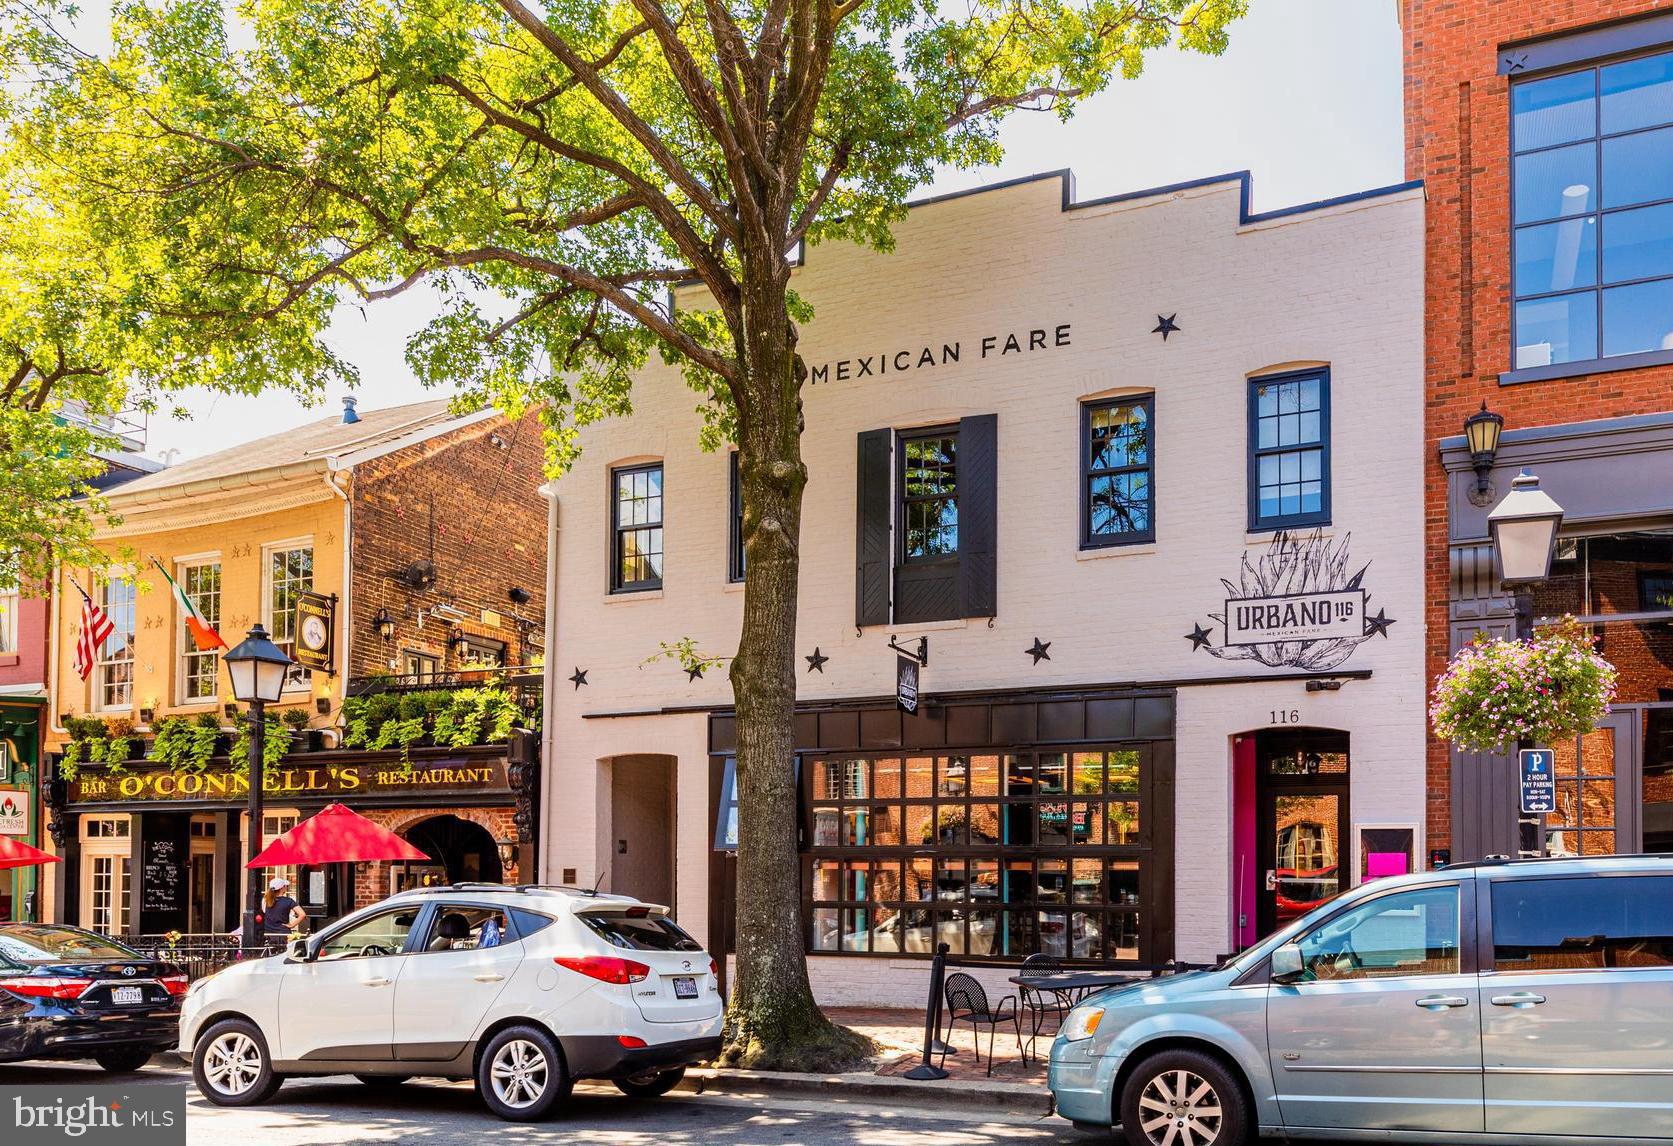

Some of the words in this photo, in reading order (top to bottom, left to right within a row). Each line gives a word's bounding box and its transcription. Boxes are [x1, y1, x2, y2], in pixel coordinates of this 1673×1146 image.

[811, 342, 960, 385] MEXICAN
[981, 324, 1071, 358] FARE
[1236, 600, 1332, 631] URBANO
[1335, 602, 1354, 617] 116
[1270, 709, 1299, 724] 116
[1531, 752, 1542, 771] P
[80, 781, 107, 794] BAR
[377, 768, 494, 785] RESTAURANT
